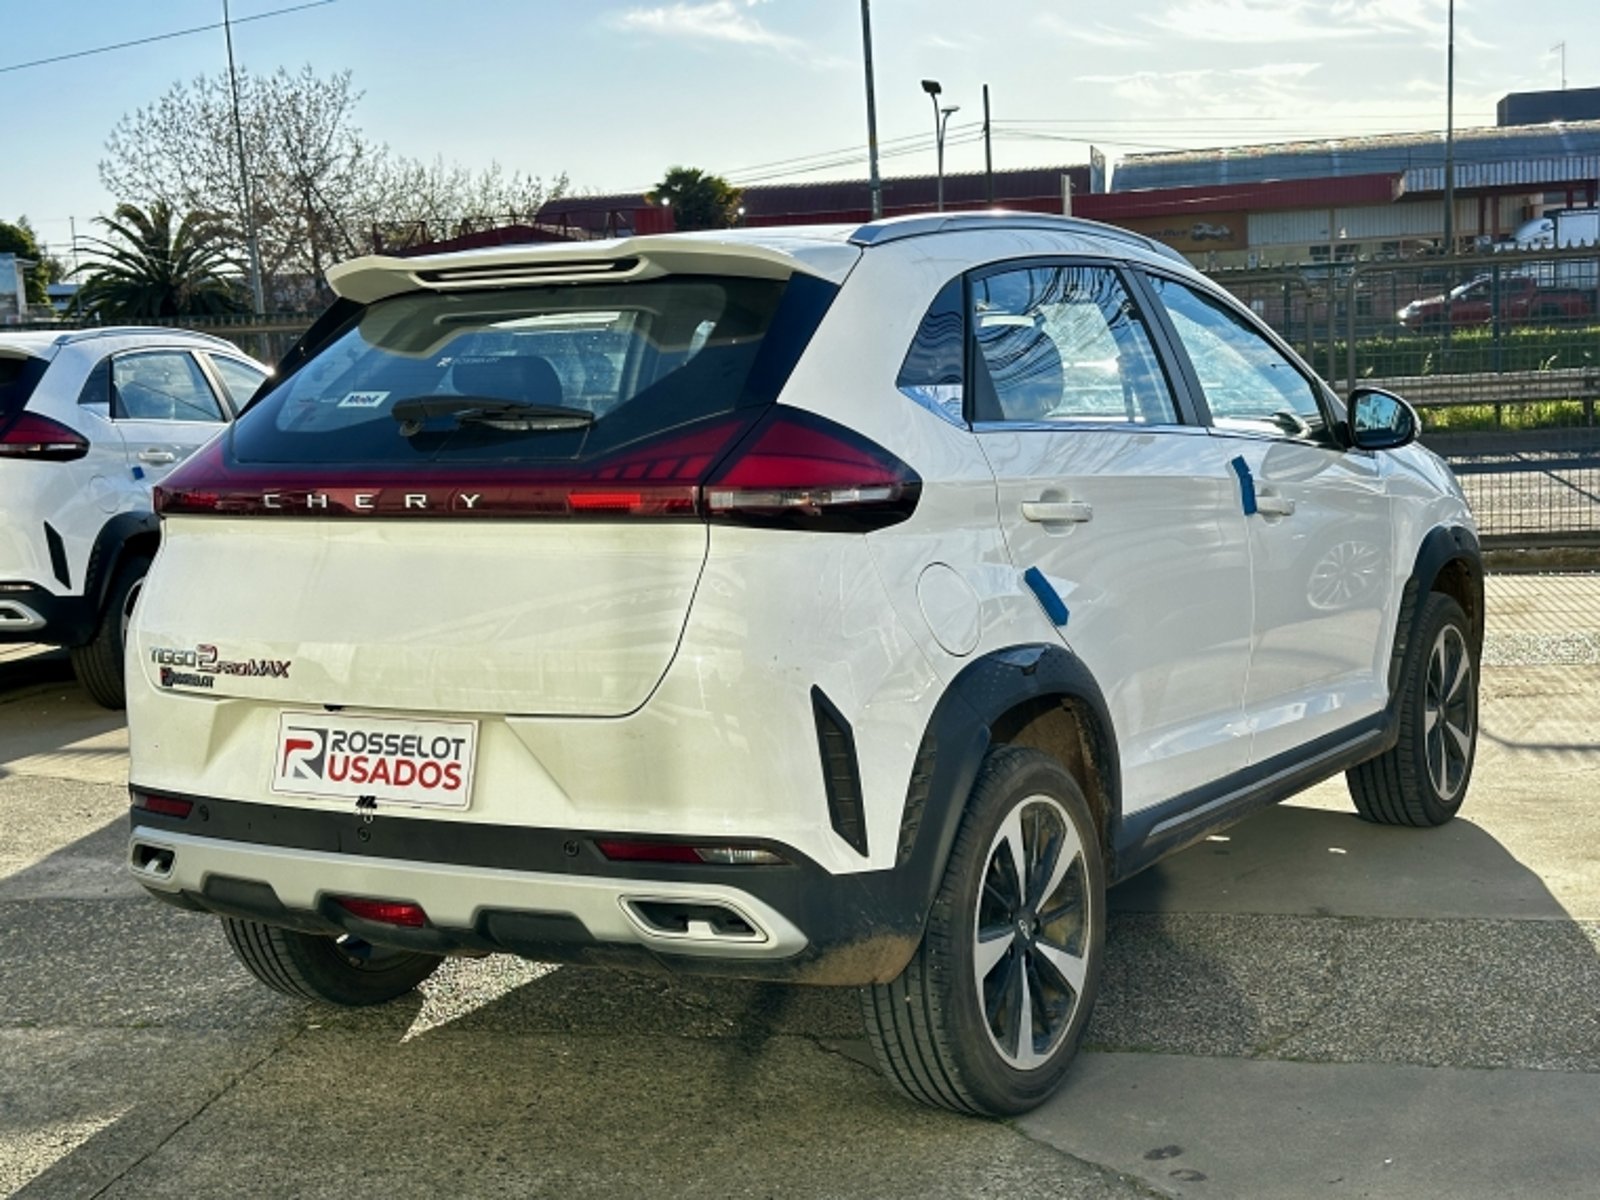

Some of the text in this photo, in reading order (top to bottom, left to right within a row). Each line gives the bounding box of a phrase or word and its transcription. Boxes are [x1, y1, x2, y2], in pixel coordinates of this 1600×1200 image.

[264, 494, 480, 509] CHERY
[332, 730, 466, 761] ROSSELOT
[328, 755, 462, 791] USADOS
